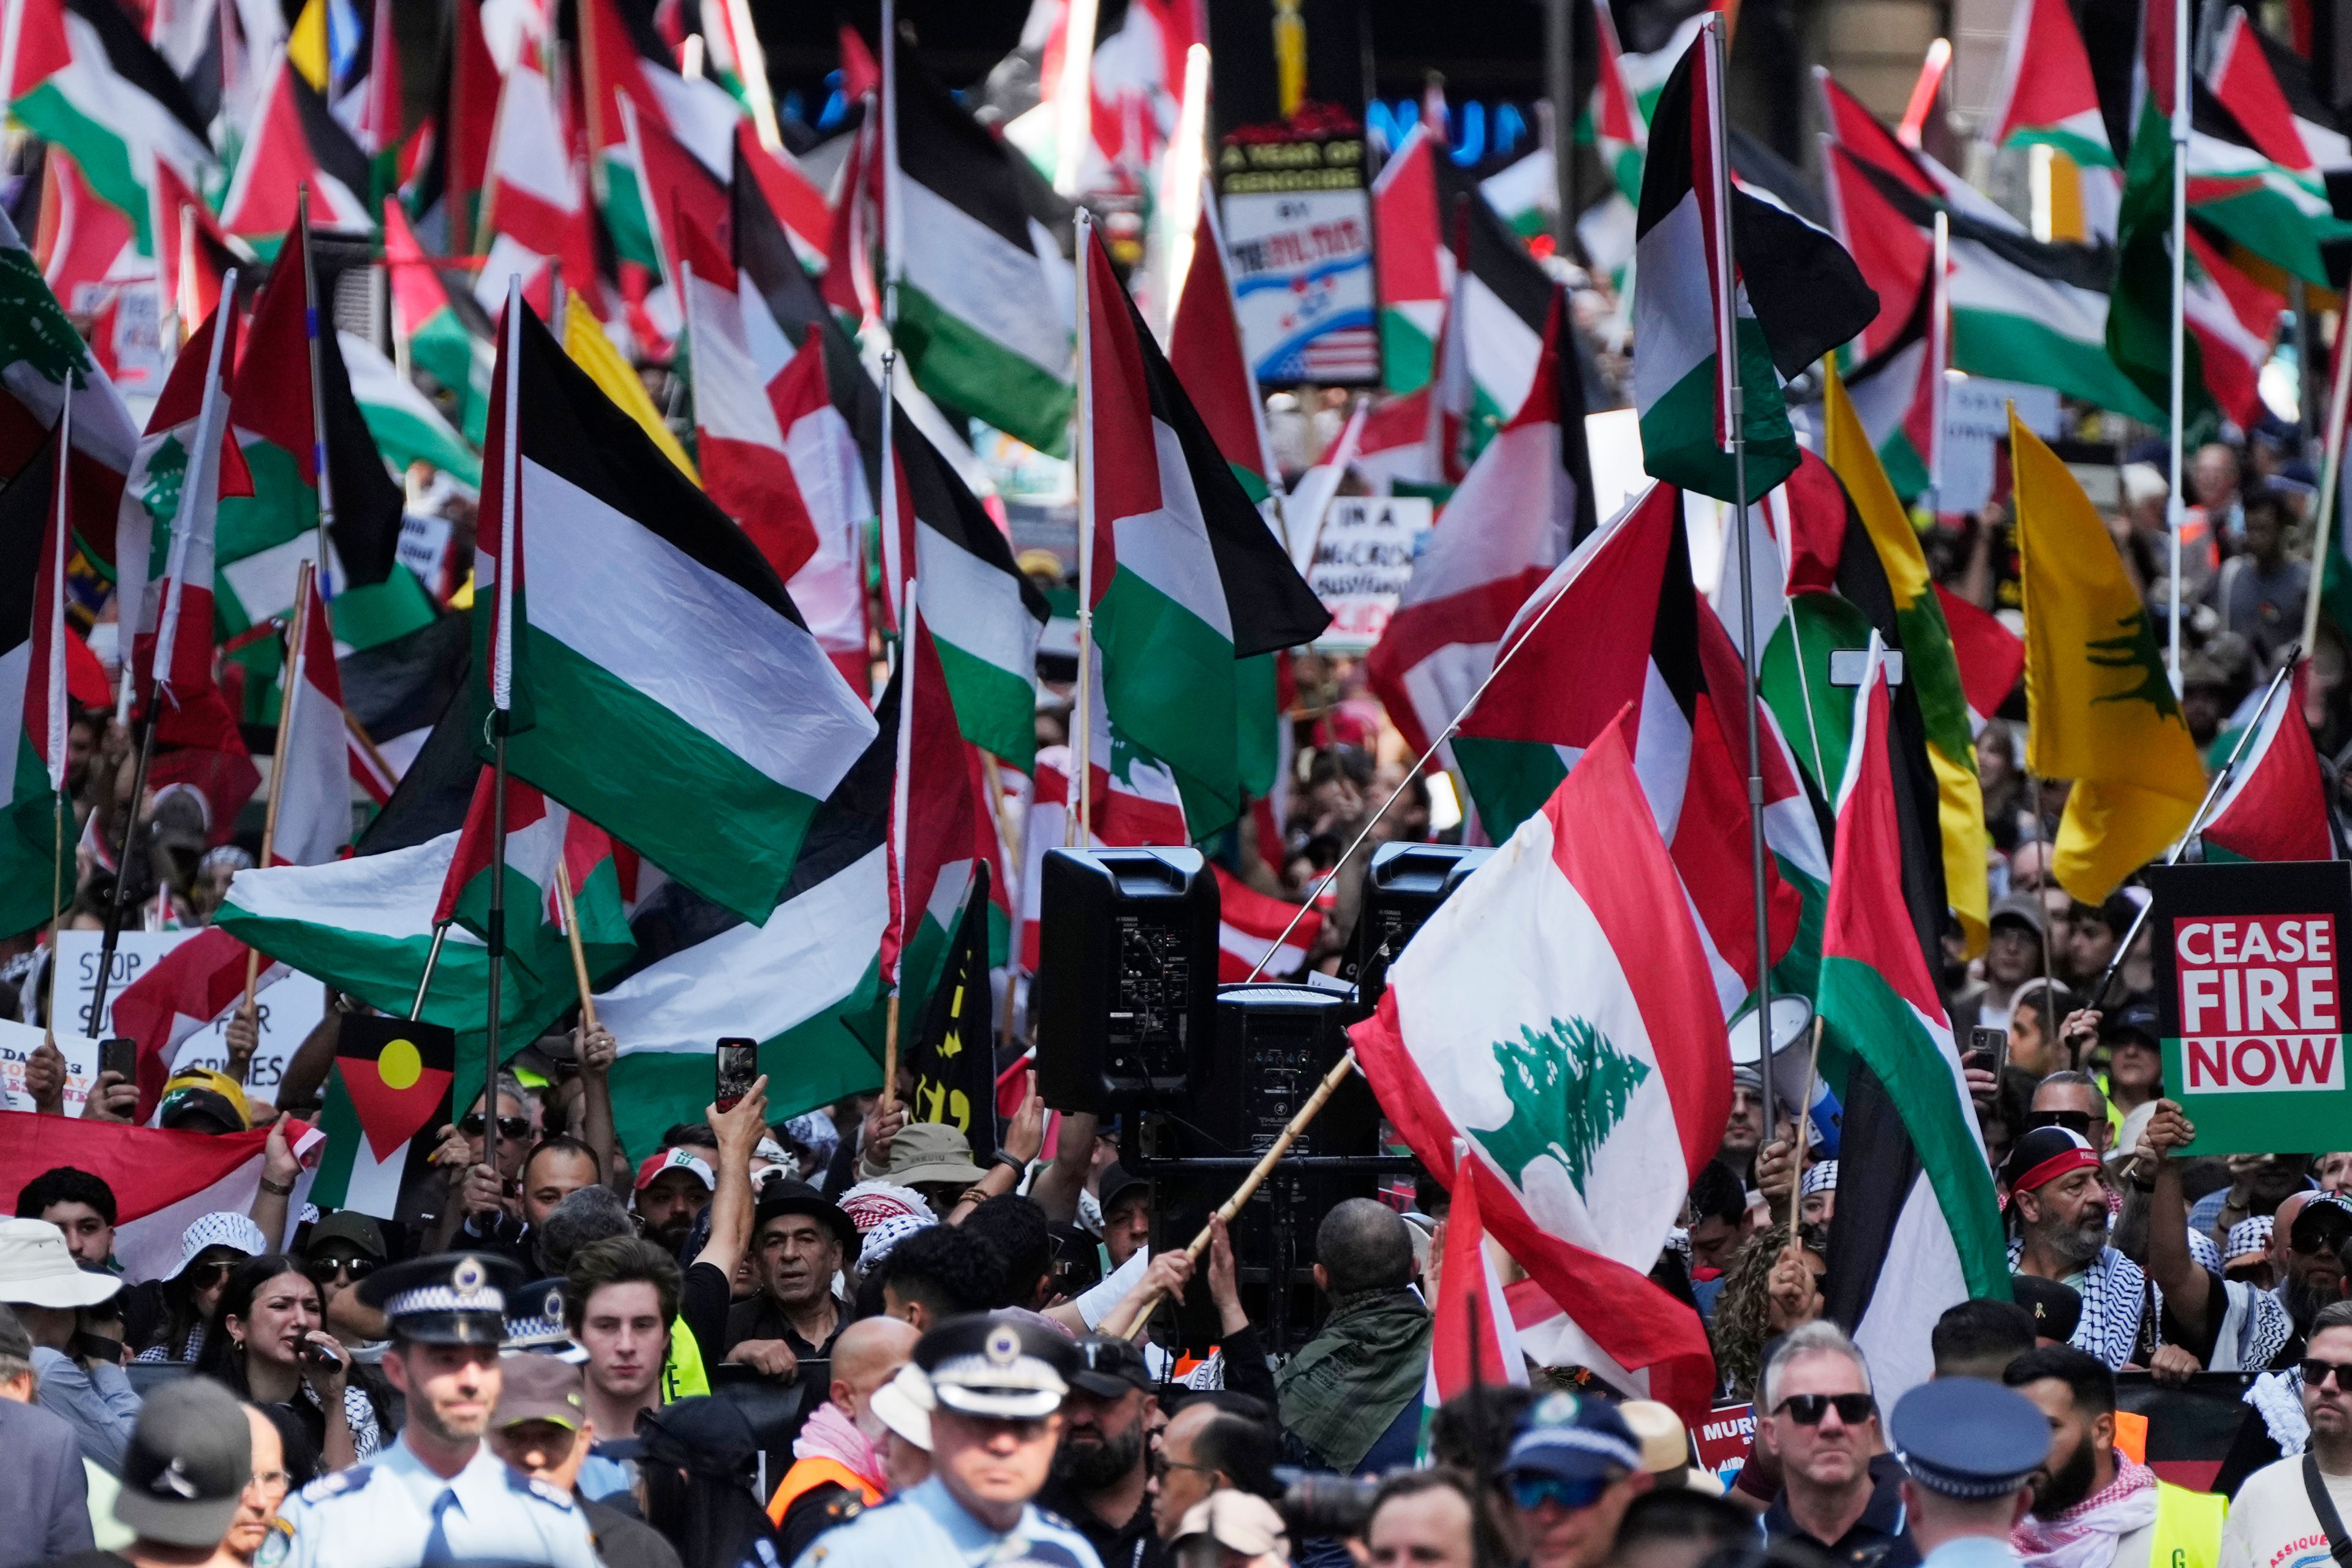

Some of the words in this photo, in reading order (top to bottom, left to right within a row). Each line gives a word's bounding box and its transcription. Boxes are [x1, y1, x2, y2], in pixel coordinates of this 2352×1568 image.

[1246, 143, 1319, 168] YEAR
[1225, 168, 1360, 193] GENOCIDE
[2178, 921, 2331, 964] CEASE
[2183, 967, 2336, 1033] FIRE
[2188, 1038, 2337, 1087] NOW
